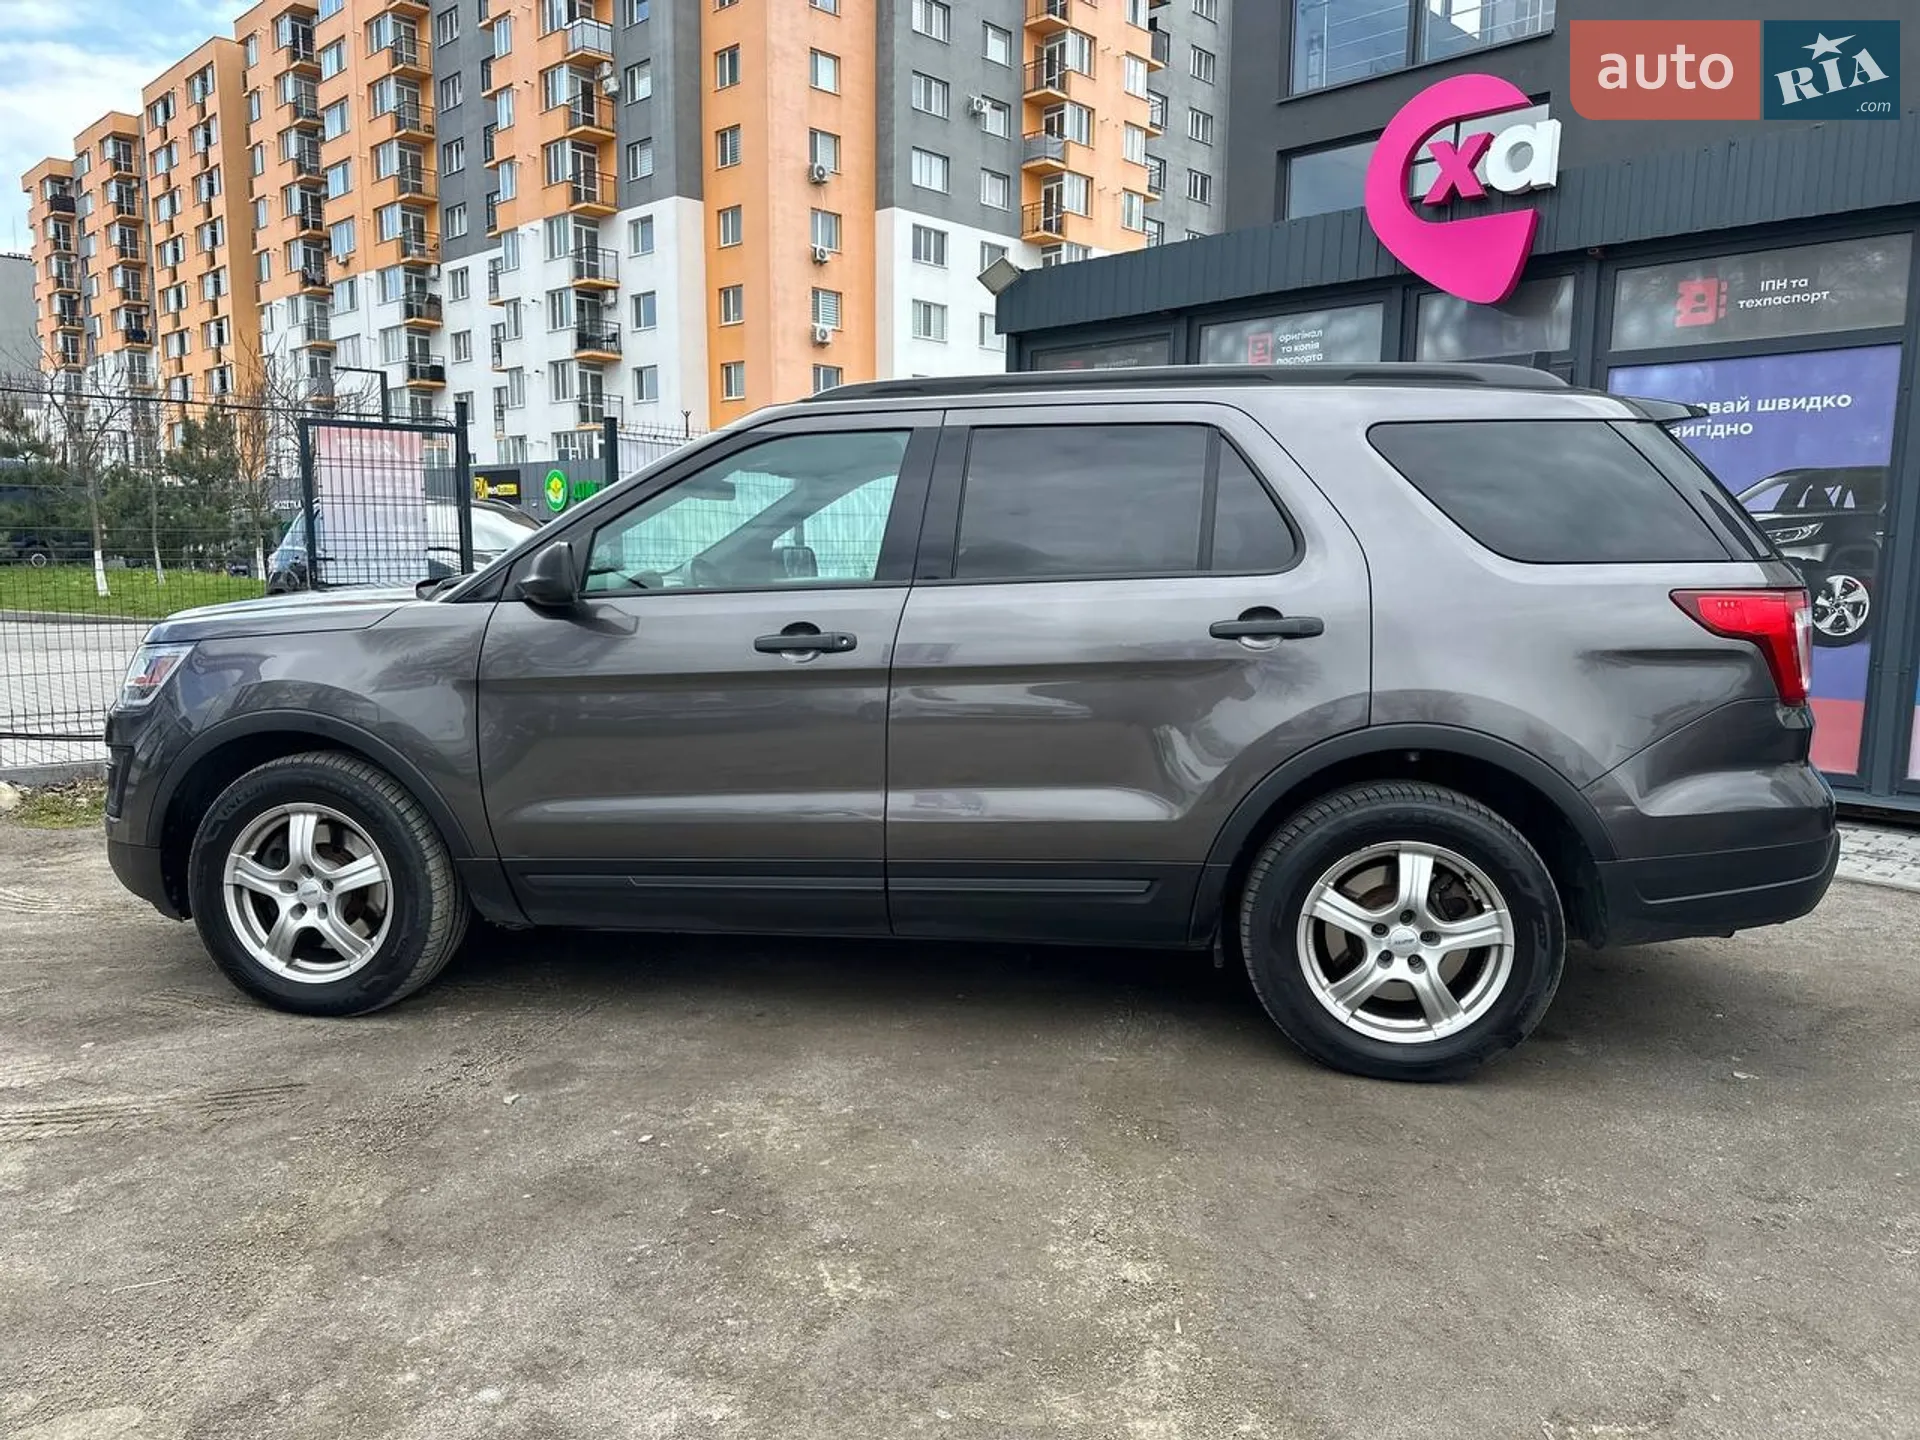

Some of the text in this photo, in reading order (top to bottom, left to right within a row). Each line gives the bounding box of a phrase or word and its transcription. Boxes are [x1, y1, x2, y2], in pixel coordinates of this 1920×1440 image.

[1760, 278, 1809, 292] ІПН та
[1737, 290, 1830, 309] техпаспорт
[1279, 330, 1322, 342] оригінал
[1294, 341, 1319, 351] копія
[1756, 394, 1853, 412] швидко
[1669, 418, 1753, 440] вигідно
